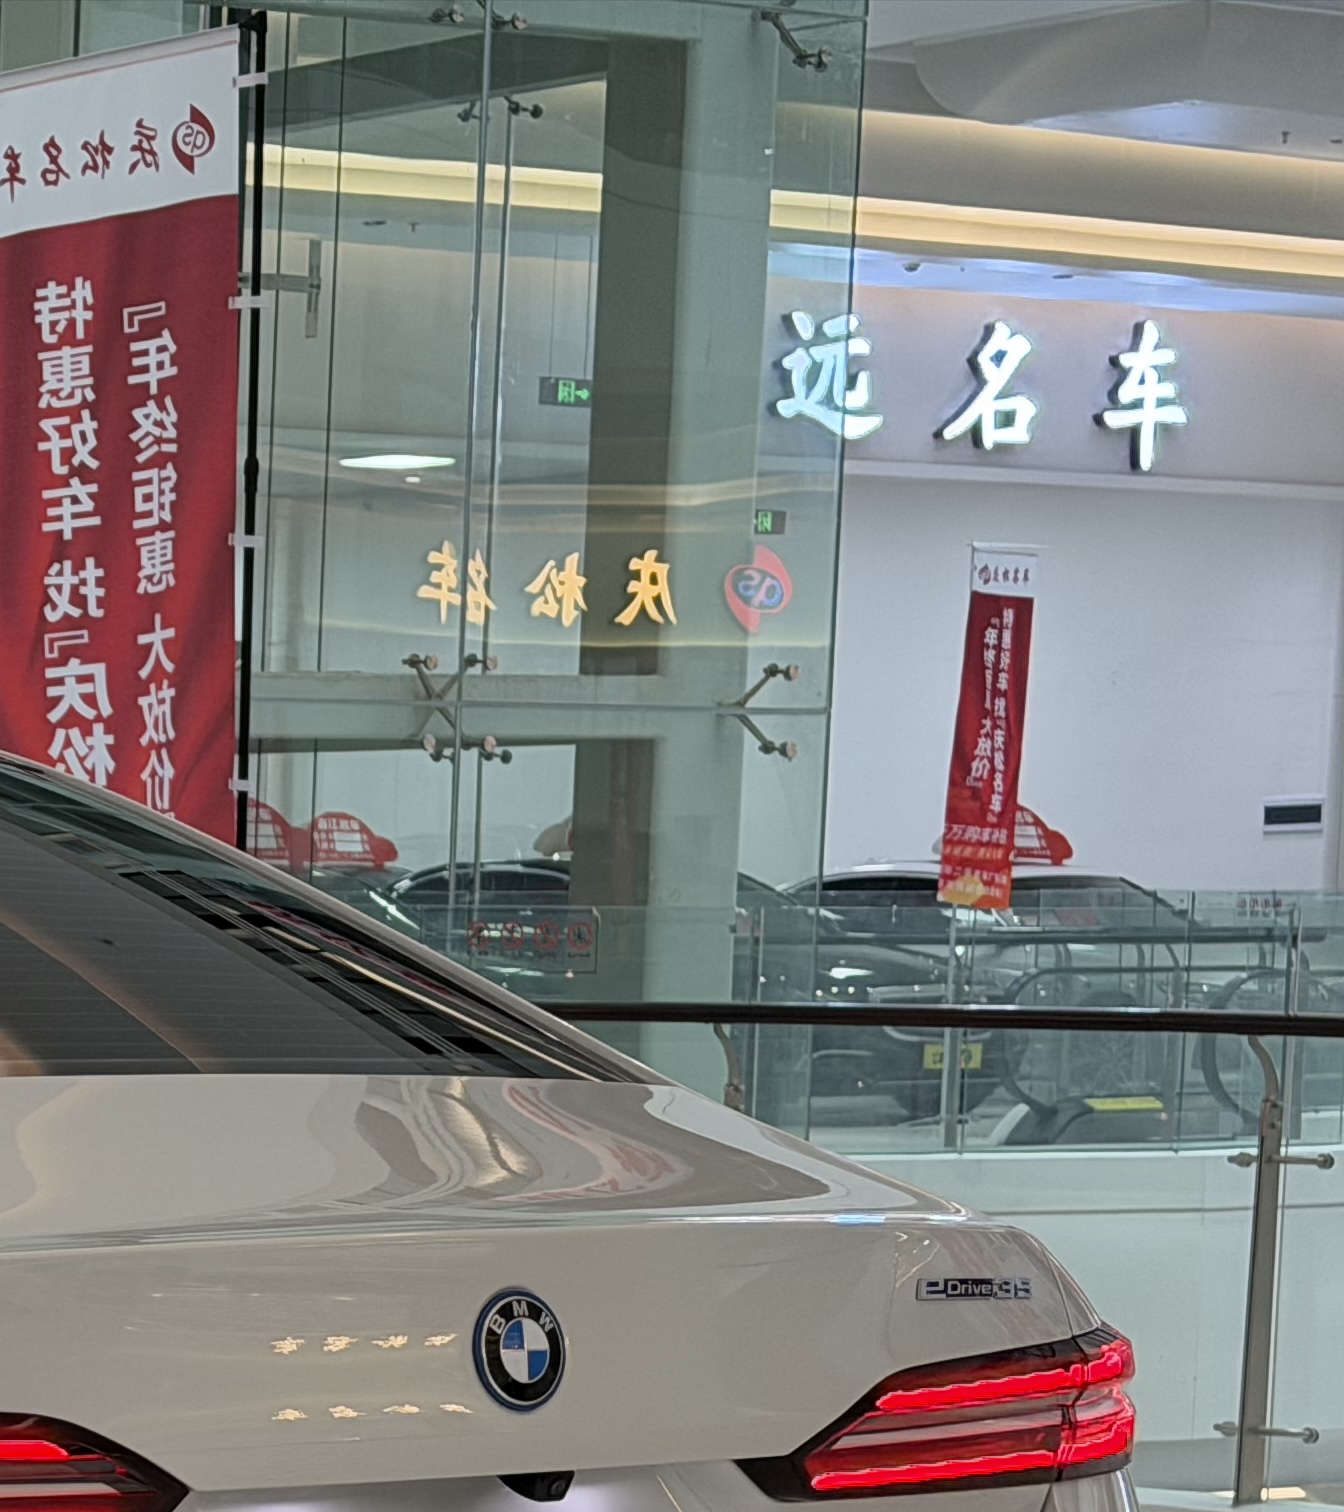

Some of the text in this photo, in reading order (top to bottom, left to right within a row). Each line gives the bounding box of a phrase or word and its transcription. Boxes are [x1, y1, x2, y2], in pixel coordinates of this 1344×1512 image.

[776, 310, 1189, 471] 远名车
[489, 1300, 554, 1335] BMW
